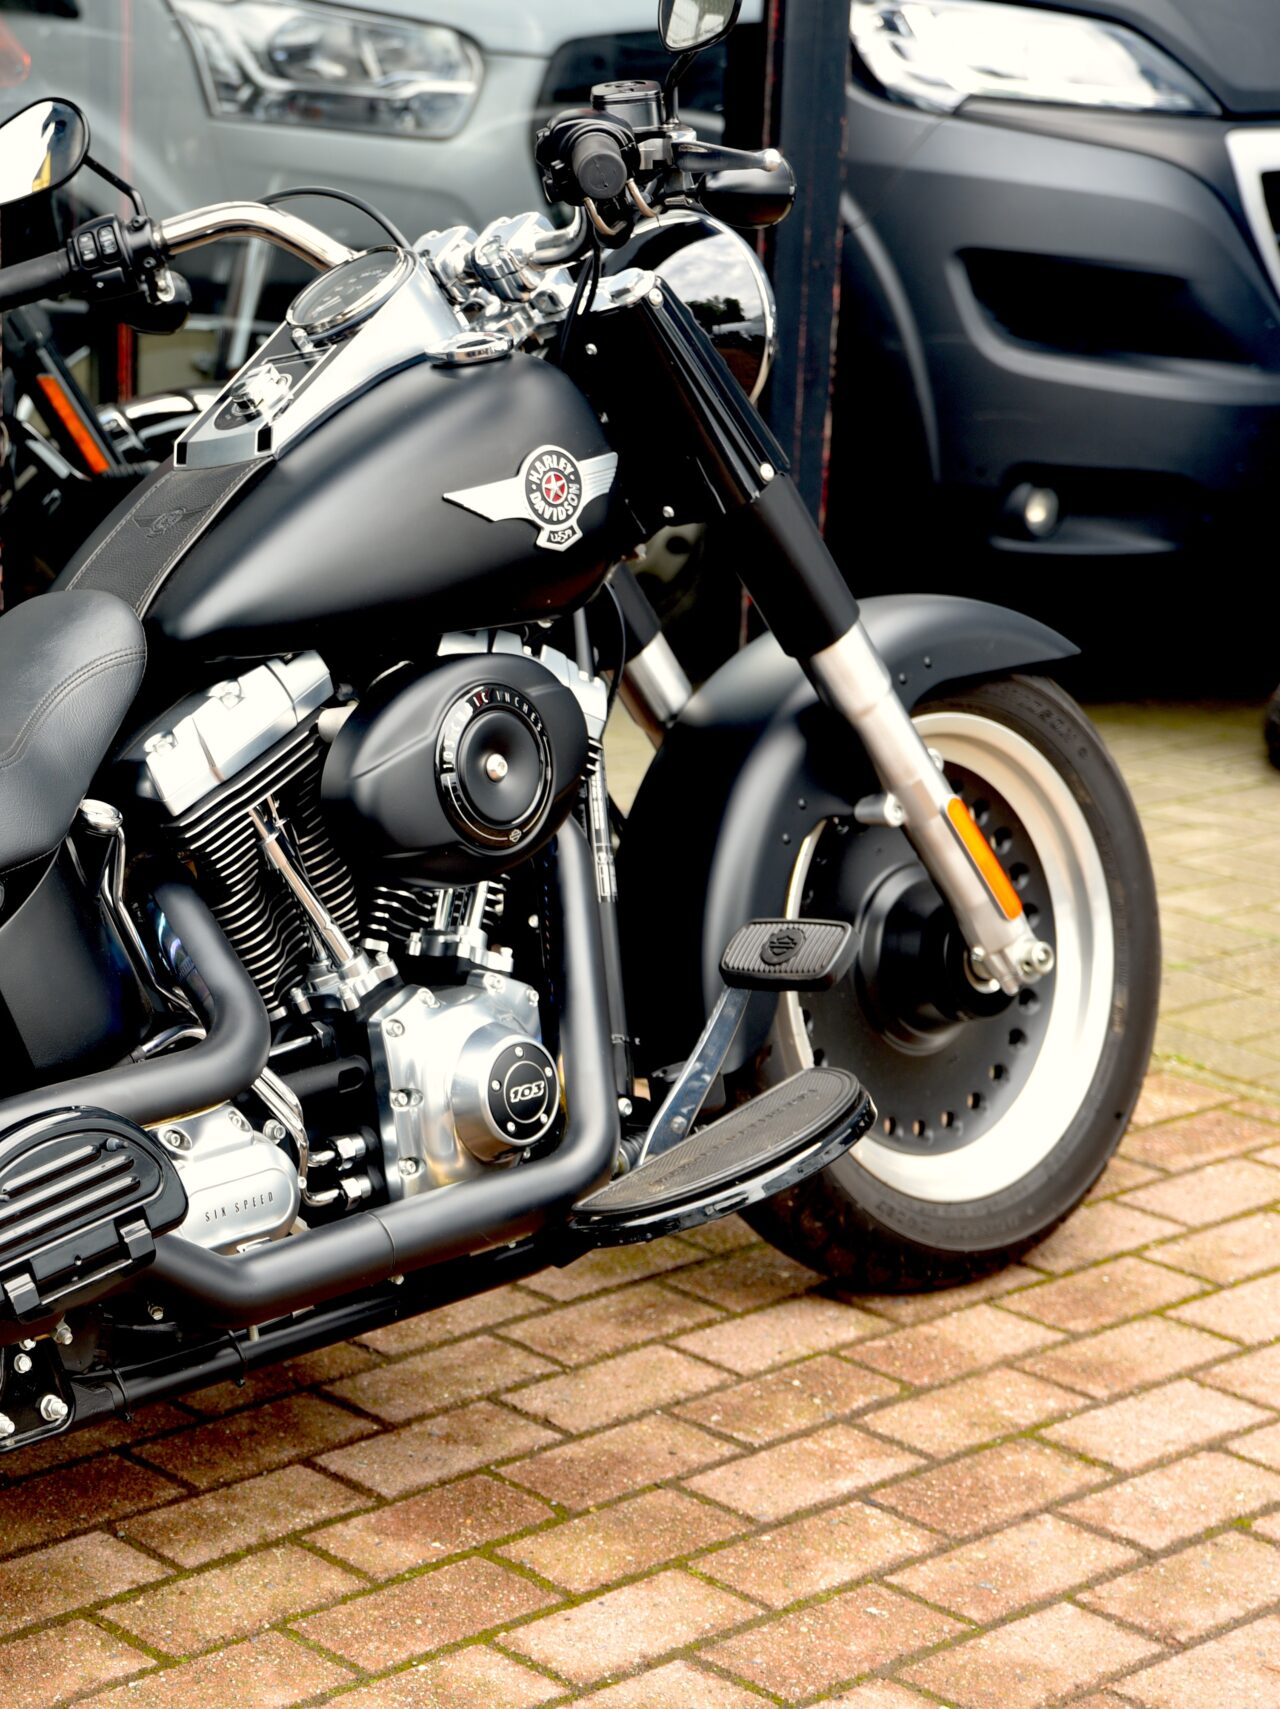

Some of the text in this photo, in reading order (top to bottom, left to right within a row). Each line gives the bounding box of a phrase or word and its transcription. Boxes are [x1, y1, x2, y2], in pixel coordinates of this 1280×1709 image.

[528, 454, 575, 484] HARLEY
[529, 483, 580, 522] DAVIDSON
[495, 690, 543, 732] INCHES
[509, 1080, 545, 1104] 103
[204, 1191, 275, 1223] SIX SPEED
